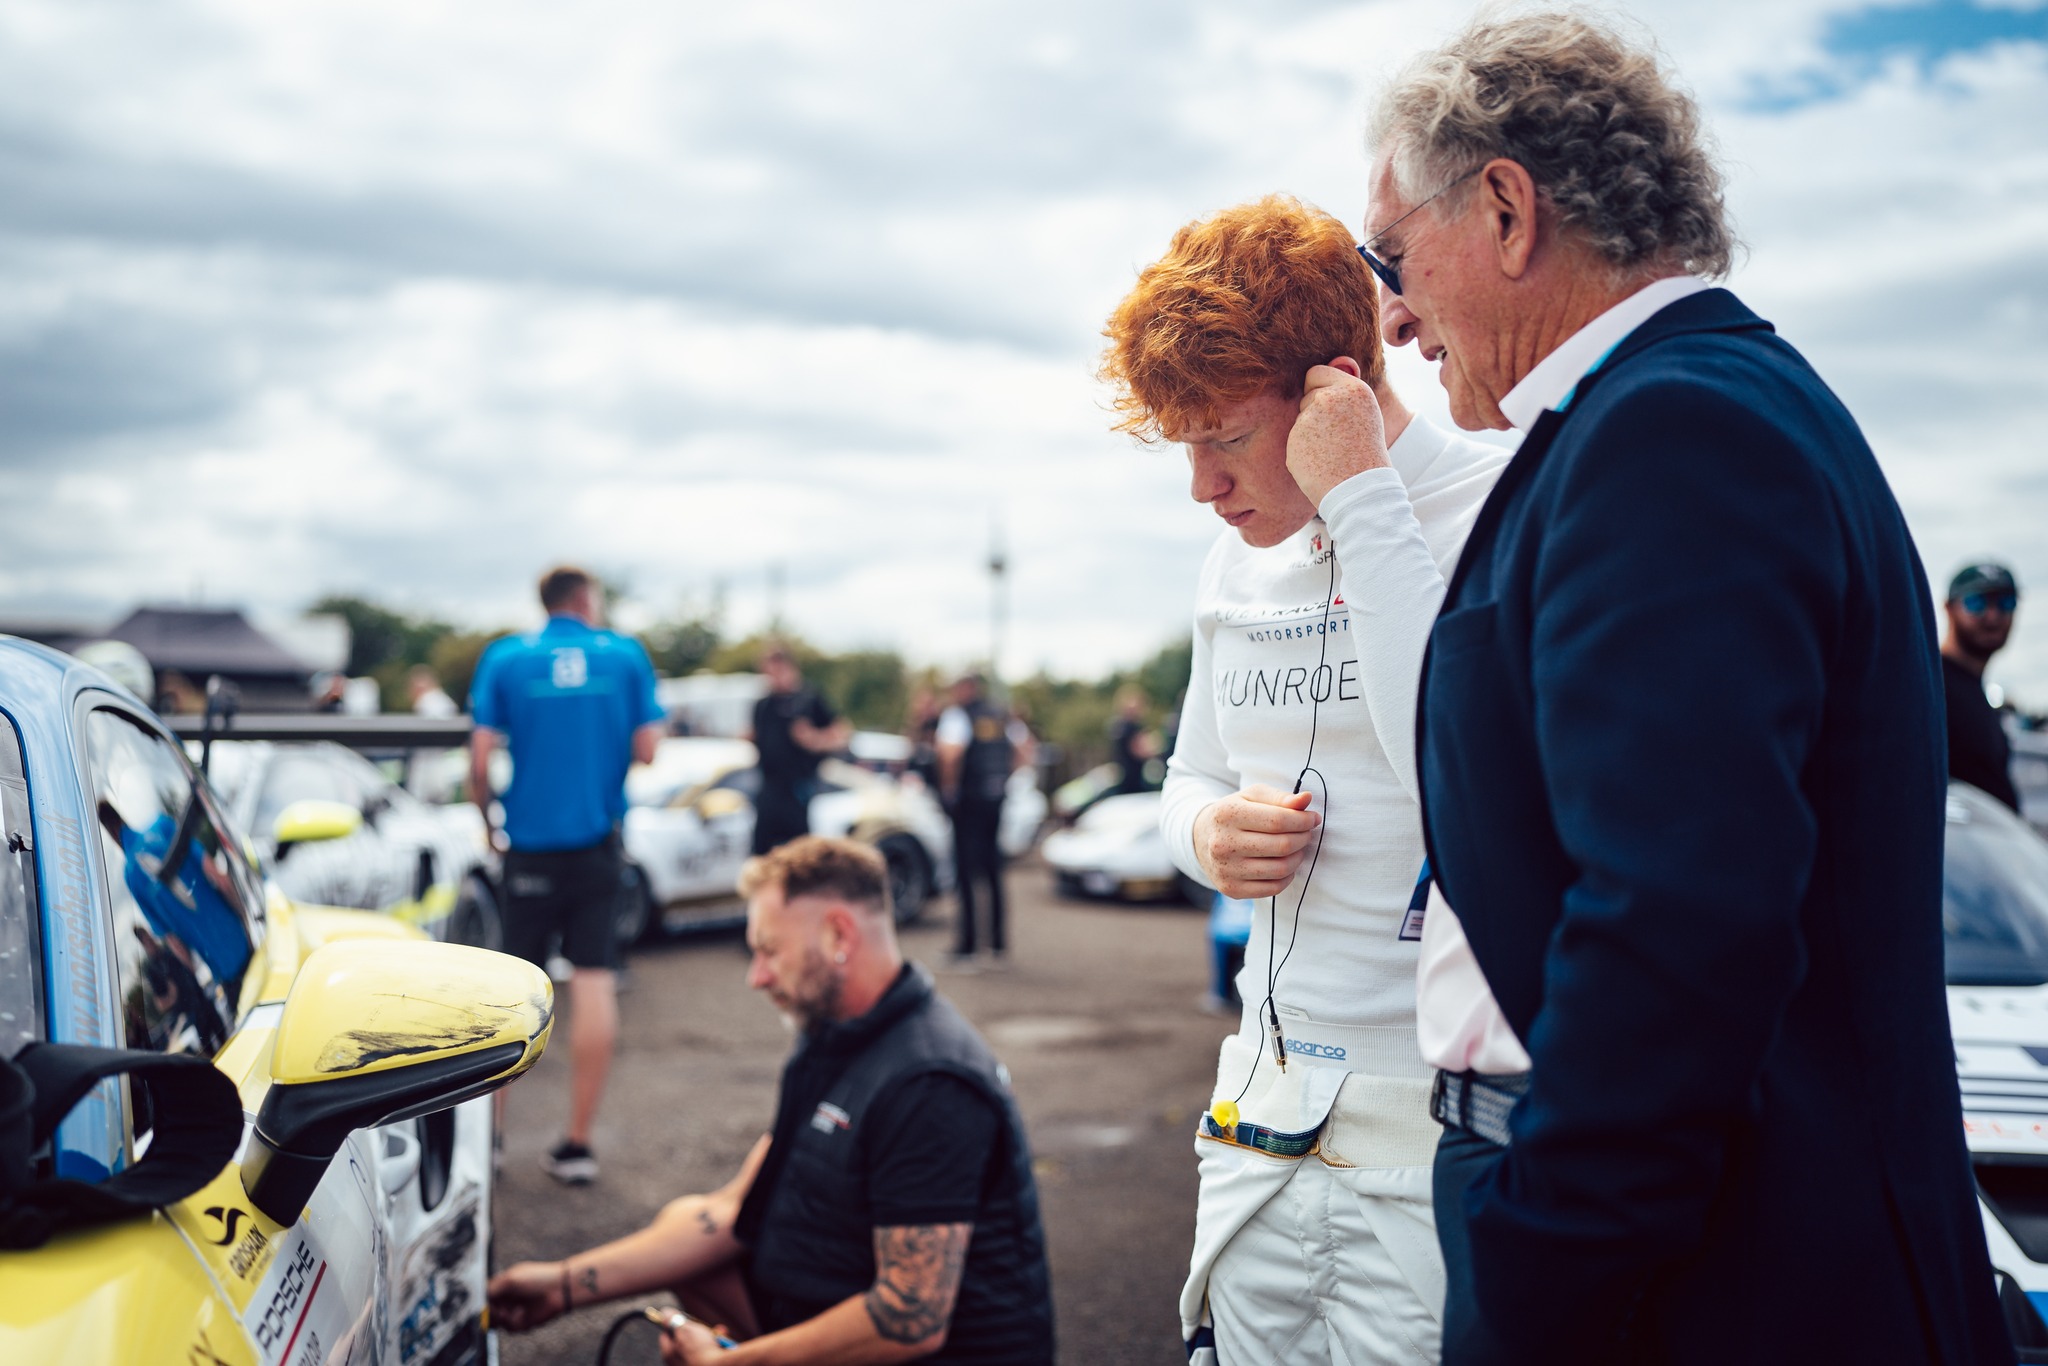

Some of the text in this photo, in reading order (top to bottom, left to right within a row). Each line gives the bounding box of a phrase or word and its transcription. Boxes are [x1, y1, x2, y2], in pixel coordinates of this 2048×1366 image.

[1246, 618, 1349, 642] MOTORSPORT
[1215, 659, 1360, 706] MUNROE
[43, 808, 107, 1101] w.porsche.co.uk
[1285, 1038, 1346, 1060] sparco
[254, 1239, 316, 1358] PORSCHE
